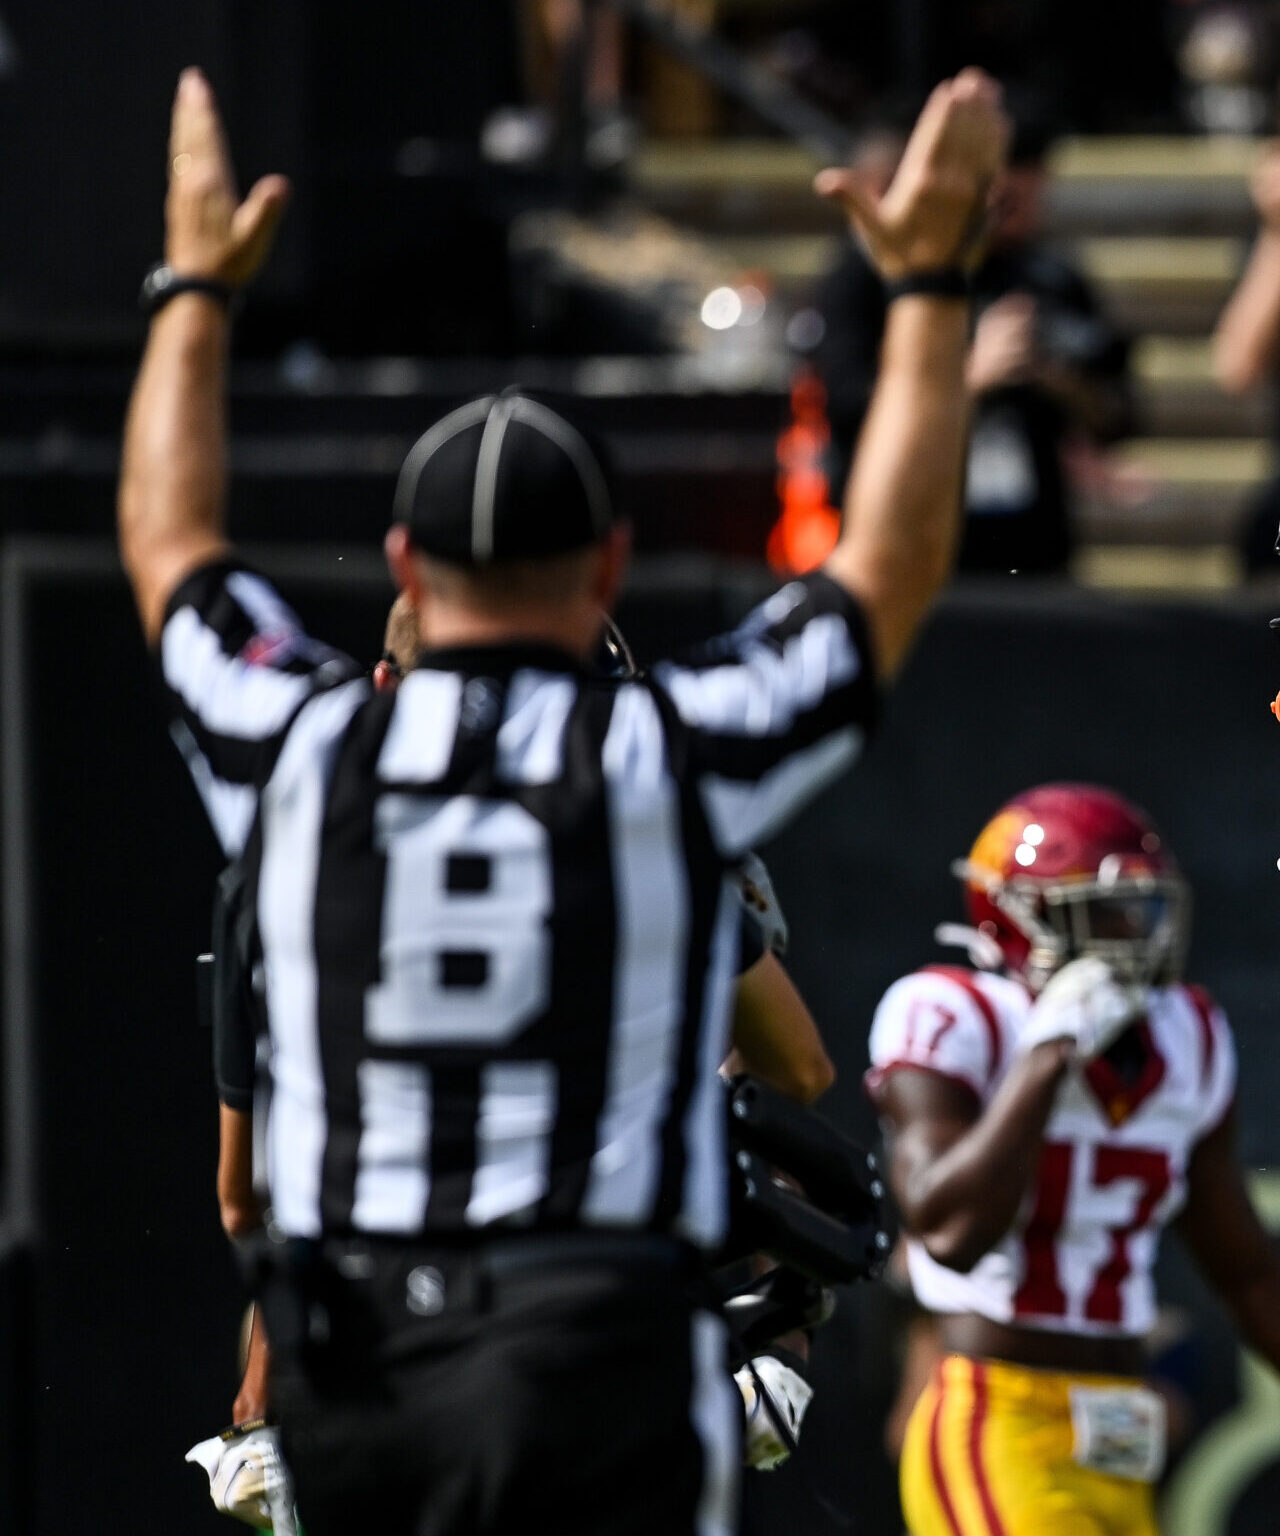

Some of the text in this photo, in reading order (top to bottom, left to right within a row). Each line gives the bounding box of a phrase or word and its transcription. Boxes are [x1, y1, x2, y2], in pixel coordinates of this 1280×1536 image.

[366, 794, 553, 1044] B
[903, 999, 957, 1066] 17
[1012, 1140, 1172, 1323] 17
